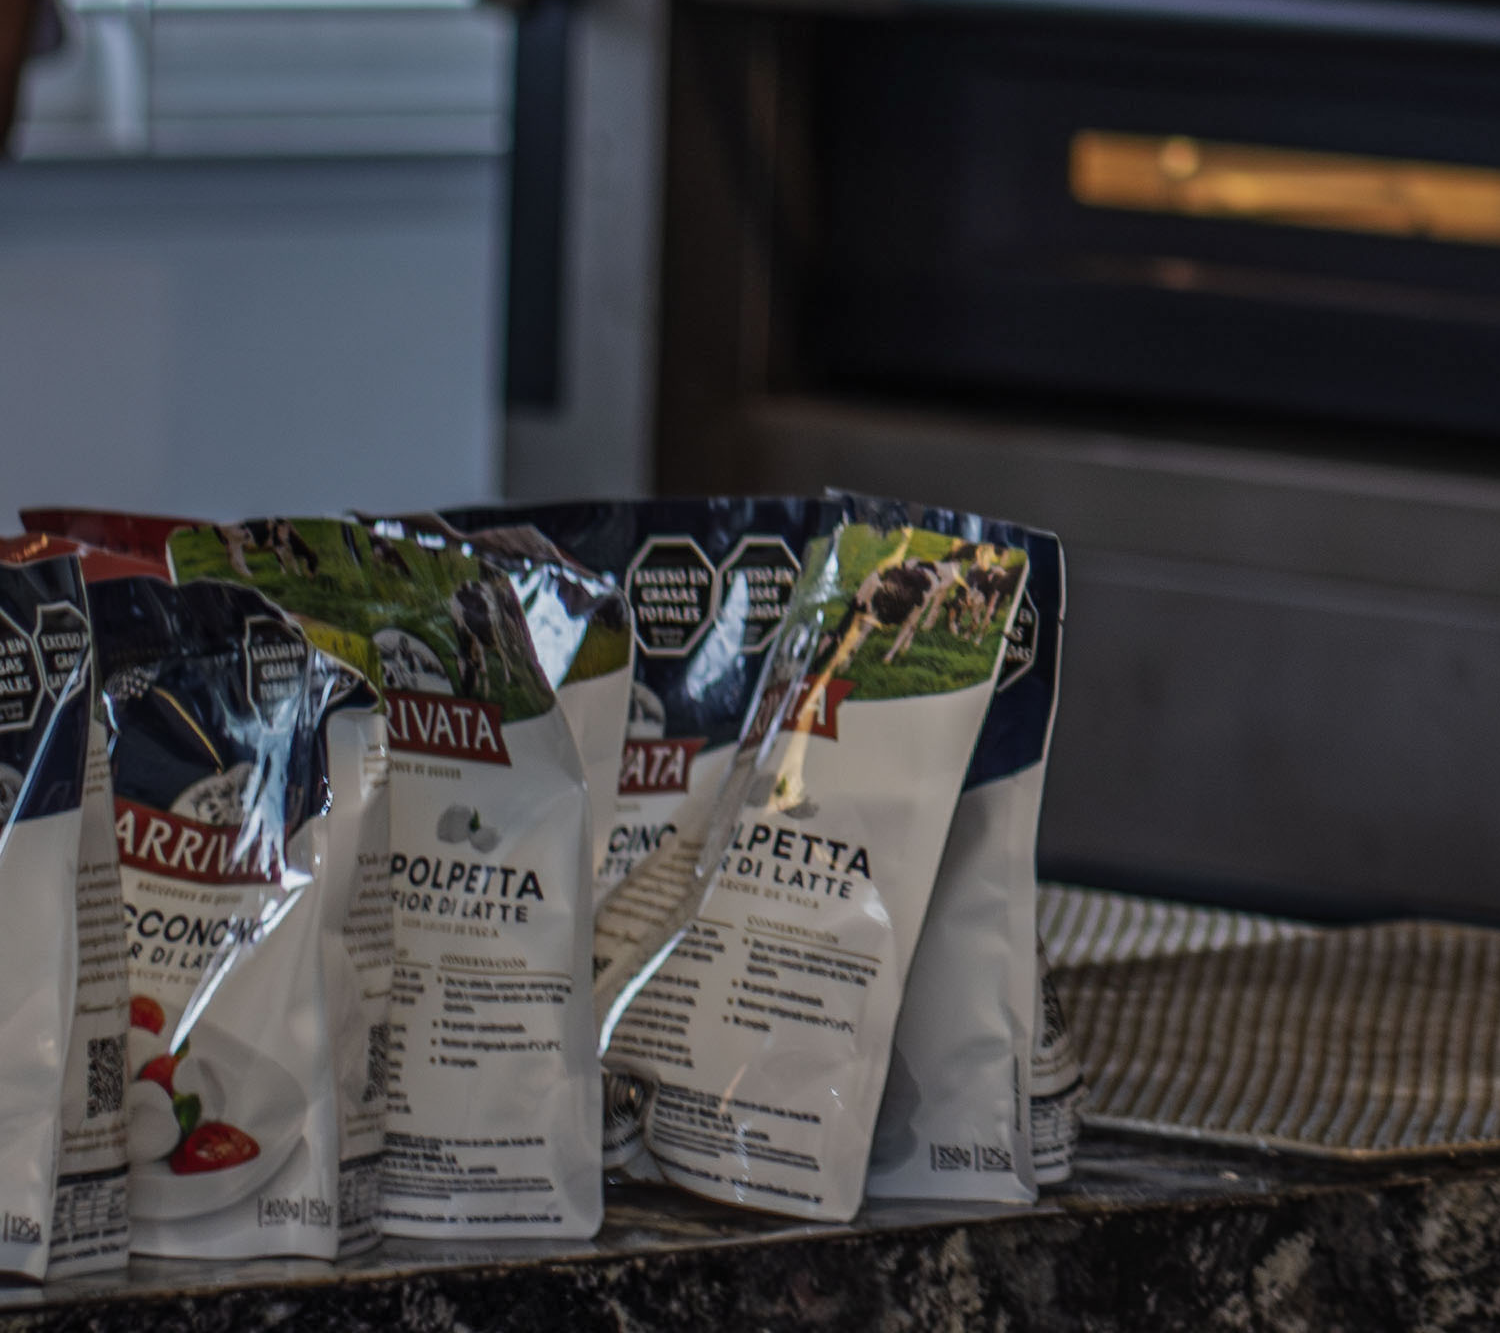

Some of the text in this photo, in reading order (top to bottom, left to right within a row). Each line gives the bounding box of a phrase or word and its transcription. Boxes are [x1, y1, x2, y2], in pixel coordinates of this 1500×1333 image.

[689, 566, 709, 585] EN
[637, 605, 701, 623] TOTALES
[384, 697, 500, 753] RIVATA
[731, 821, 872, 880] LPETTA
[391, 851, 544, 901] POLPETTA
[737, 857, 763, 879] DI
[773, 865, 853, 900] LATTE
[461, 899, 529, 924] LATTE
[151, 945, 174, 966] DI
